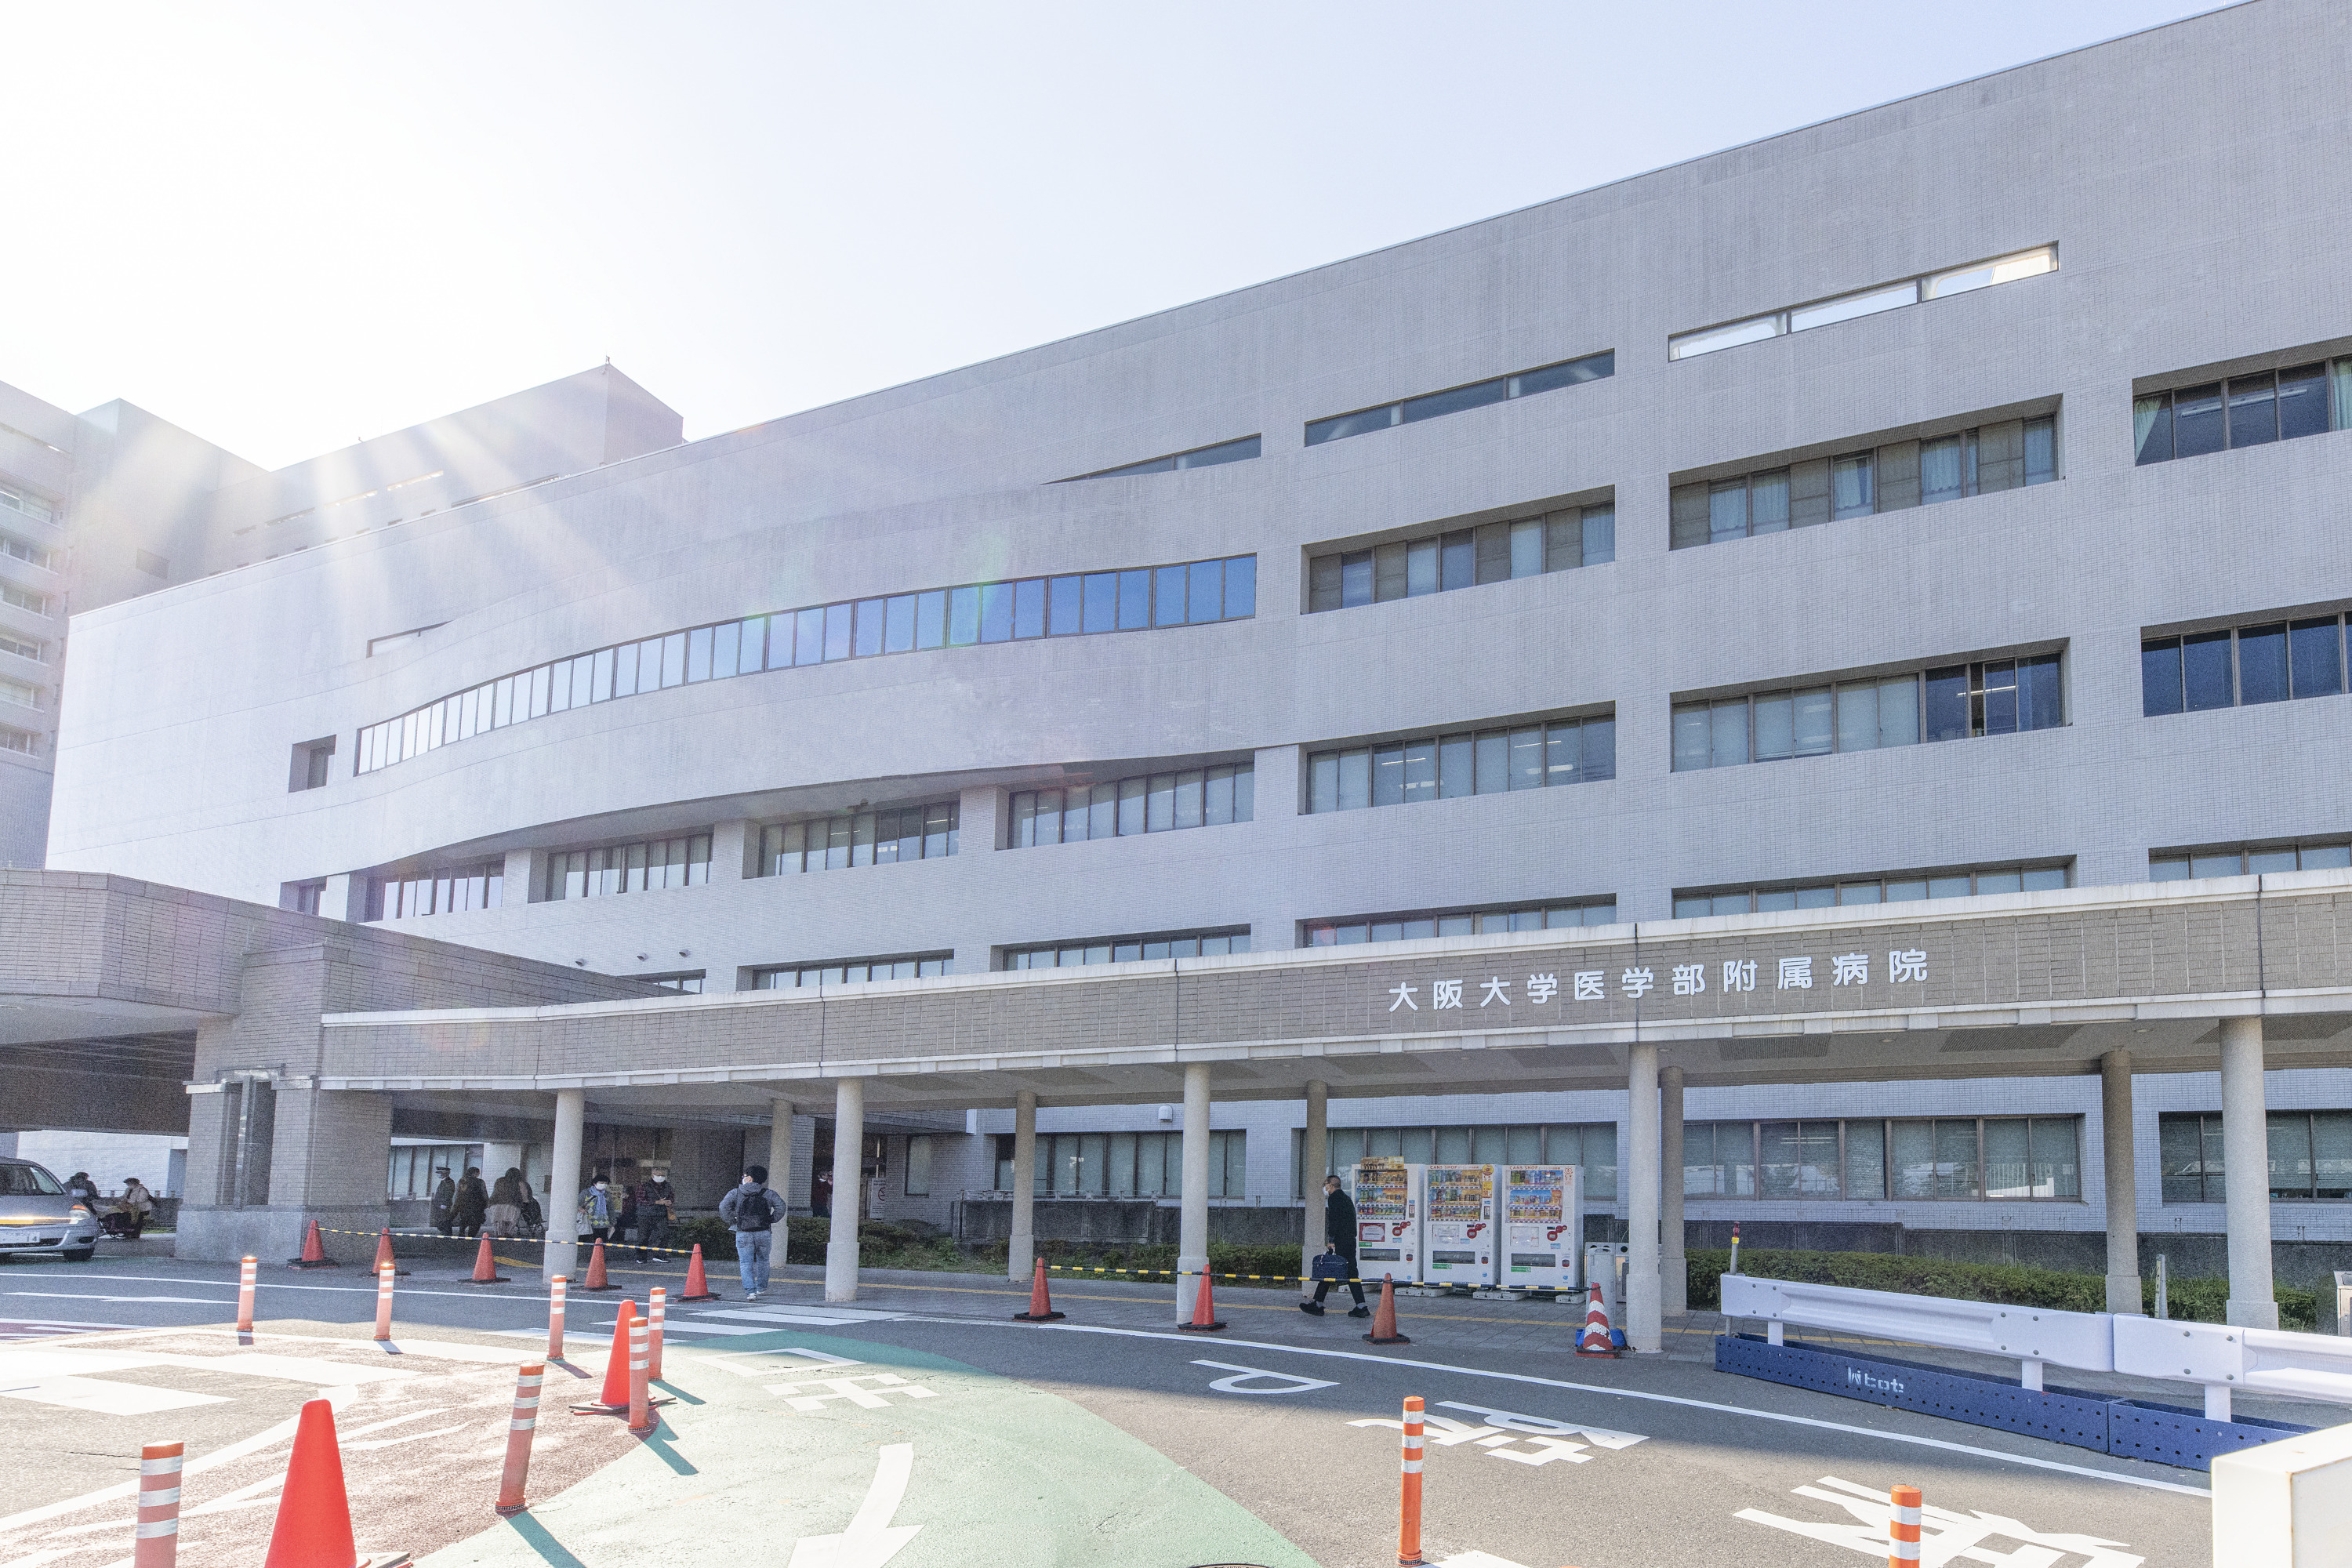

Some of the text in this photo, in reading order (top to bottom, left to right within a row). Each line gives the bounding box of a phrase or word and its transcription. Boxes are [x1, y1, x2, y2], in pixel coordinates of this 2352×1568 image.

[1388, 949, 1928, 1013] 大阪大学医学部附属病院
